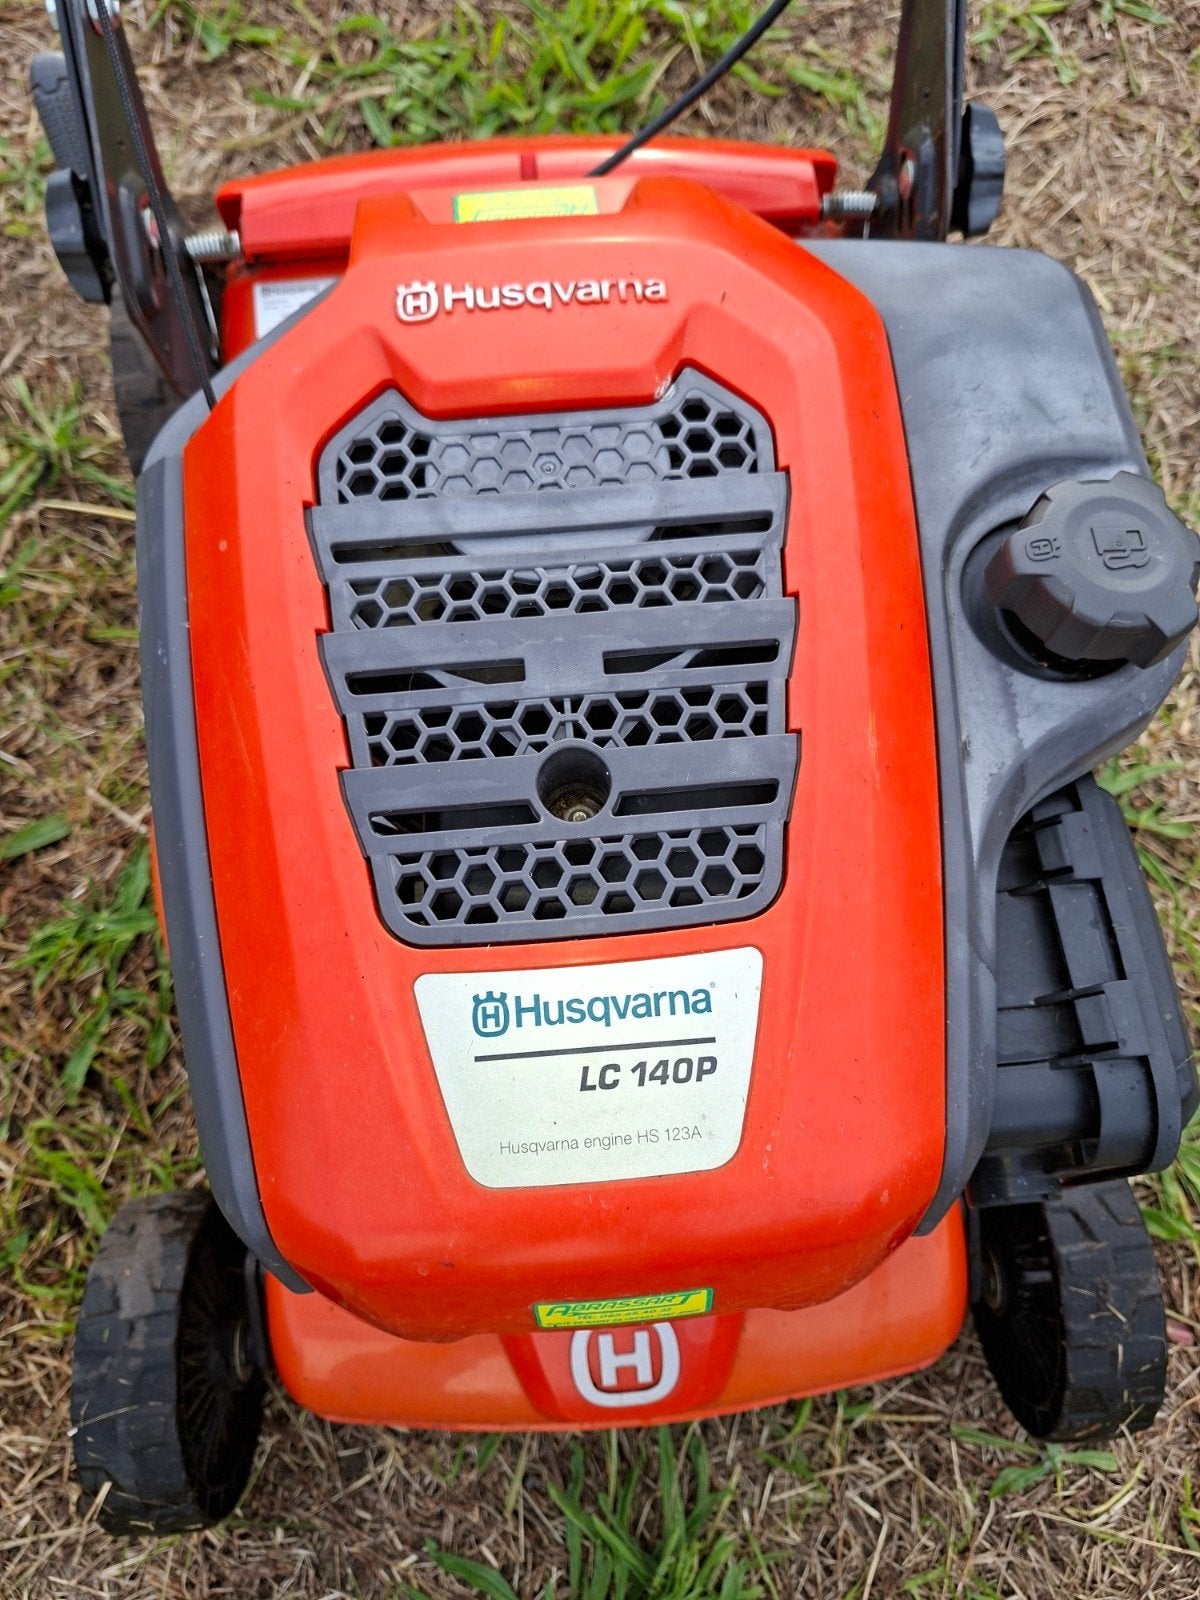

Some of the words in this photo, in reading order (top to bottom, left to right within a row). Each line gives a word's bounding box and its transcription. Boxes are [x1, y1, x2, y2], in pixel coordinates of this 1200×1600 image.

[444, 279, 668, 313] Husqvarna
[515, 988, 713, 1028] Husqvarna
[579, 1064, 621, 1092] LC
[630, 1056, 718, 1087] 140P
[500, 1137, 579, 1156] Husqvarna
[584, 1132, 632, 1150] engine
[636, 1129, 660, 1144] HS
[664, 1125, 703, 1142] 123A
[546, 1291, 701, 1317] ABRASSART
[598, 1330, 653, 1387] H
